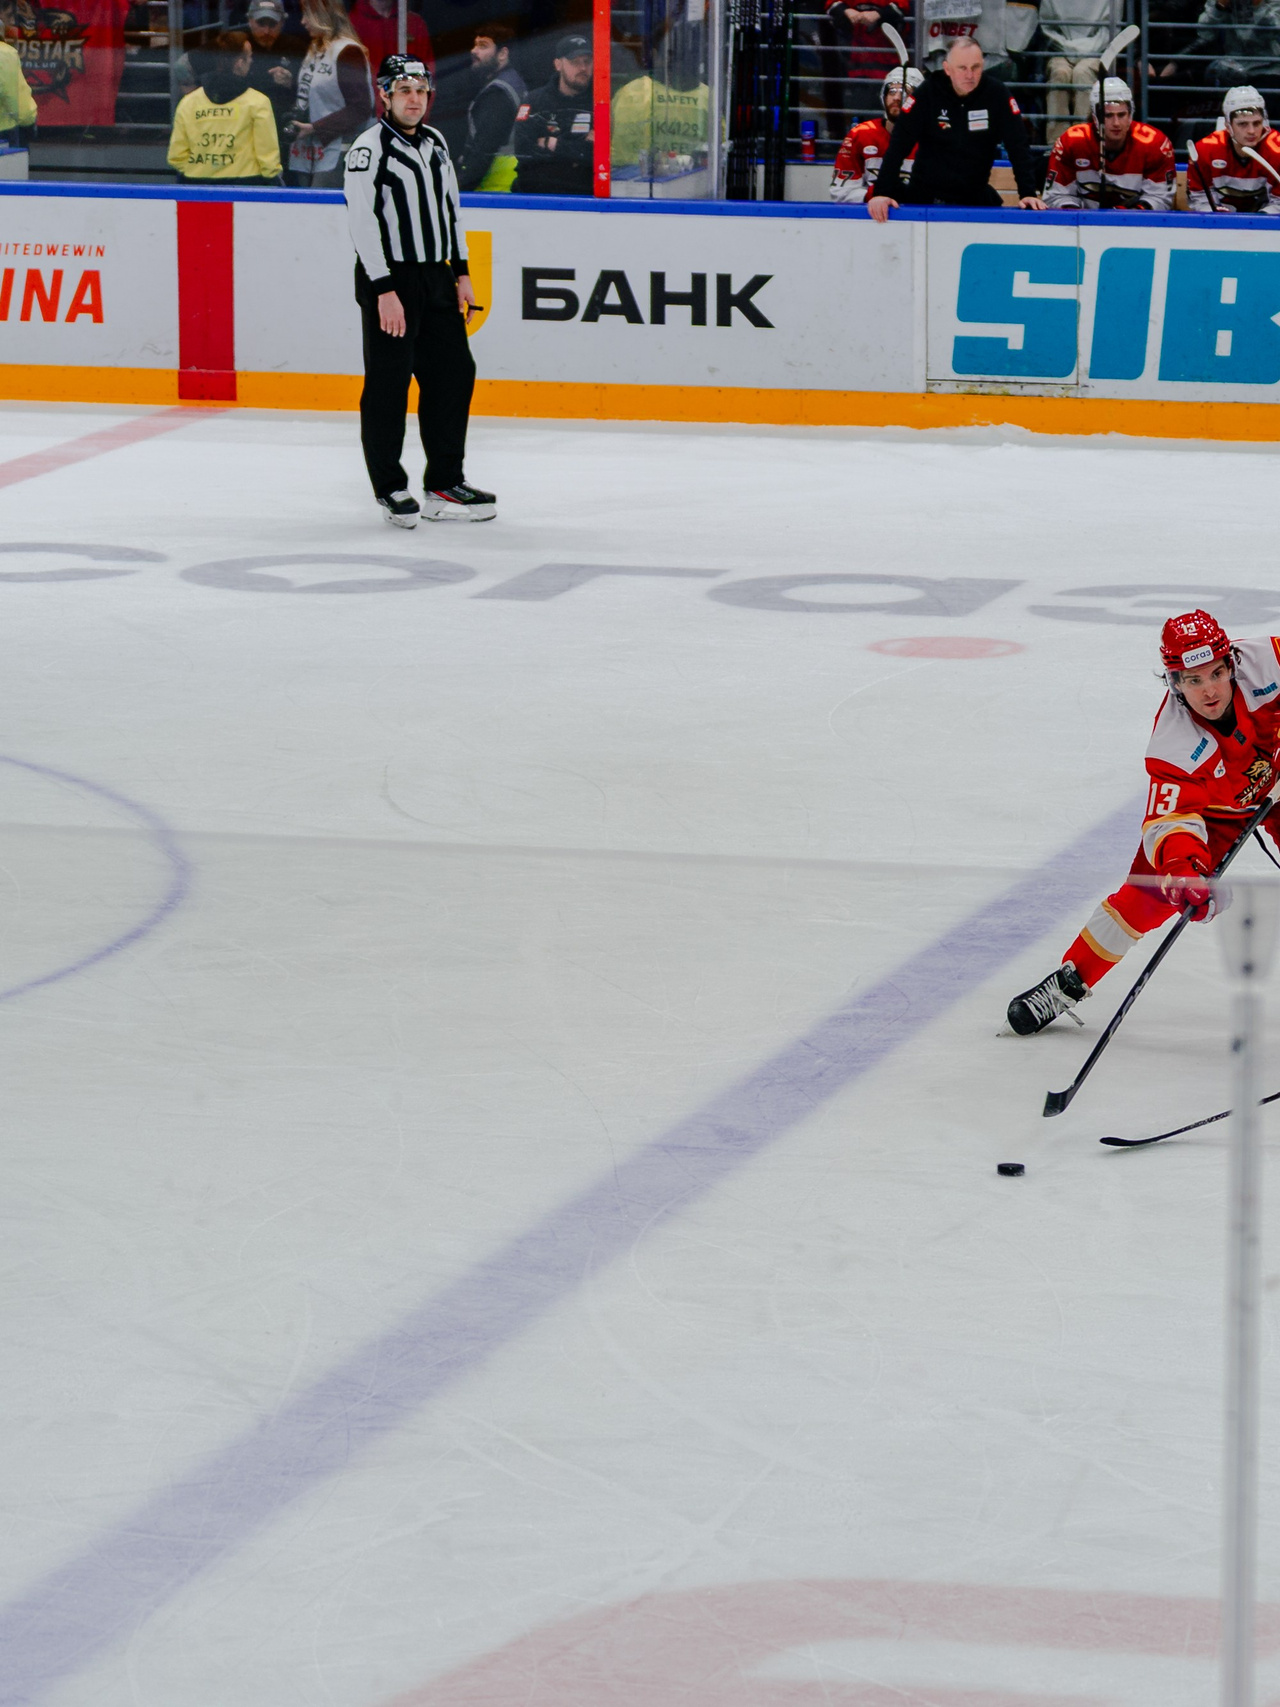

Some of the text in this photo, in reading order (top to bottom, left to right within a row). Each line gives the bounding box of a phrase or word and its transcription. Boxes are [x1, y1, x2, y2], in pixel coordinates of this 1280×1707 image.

[656, 94, 699, 105] SAFETY
[195, 107, 234, 119] SAFETY
[188, 153, 236, 165] SAFETY
[349, 149, 370, 171] 86
[834, 169, 855, 187] 17
[0, 243, 106, 258] ITEDWEWIN
[522, 267, 774, 329] БАНК
[1180, 622, 1197, 634] 13
[1184, 649, 1212, 664] согаз
[1253, 682, 1278, 698] SIBUR
[1190, 736, 1209, 762] SIBUR
[1148, 782, 1181, 816] 13
